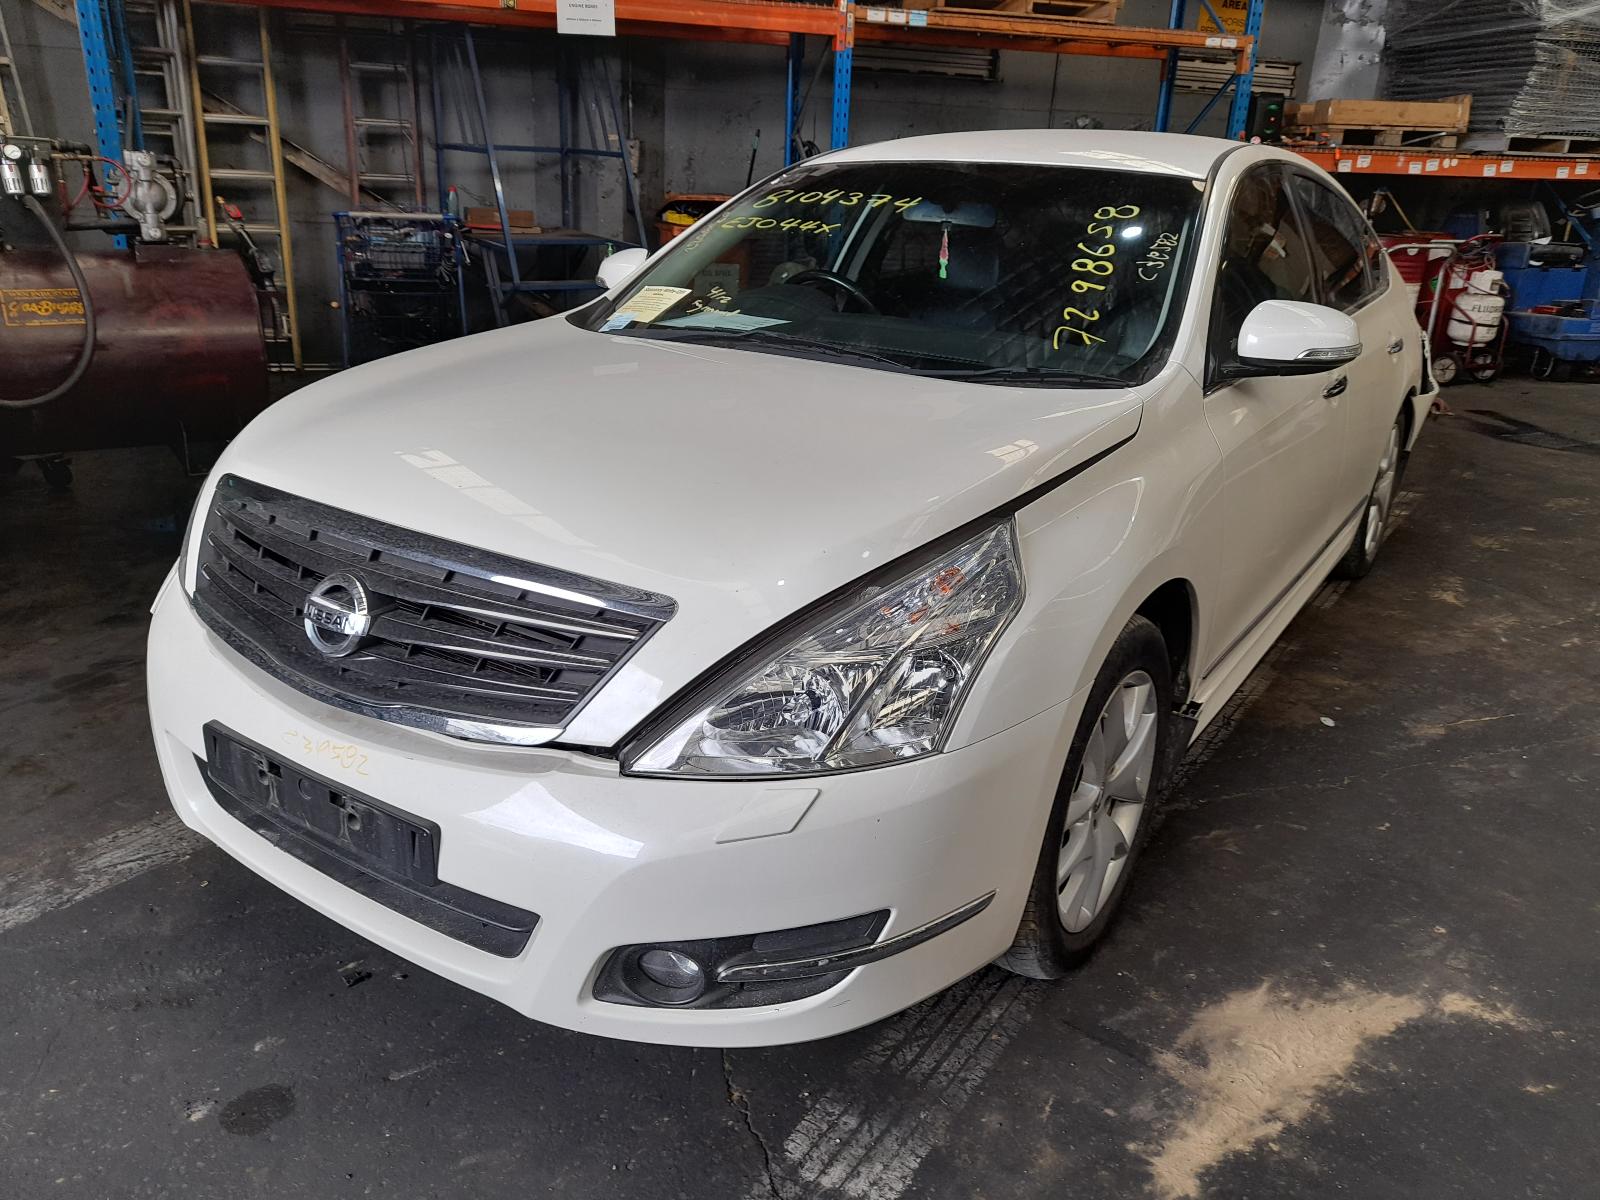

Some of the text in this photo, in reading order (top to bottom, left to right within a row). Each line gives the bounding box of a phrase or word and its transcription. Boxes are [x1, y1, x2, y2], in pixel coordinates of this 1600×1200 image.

[1222, 0, 1247, 10] AREA
[753, 188, 923, 213] 8104374
[1053, 204, 1141, 350] 7298658
[304, 602, 362, 636] NISSAN
